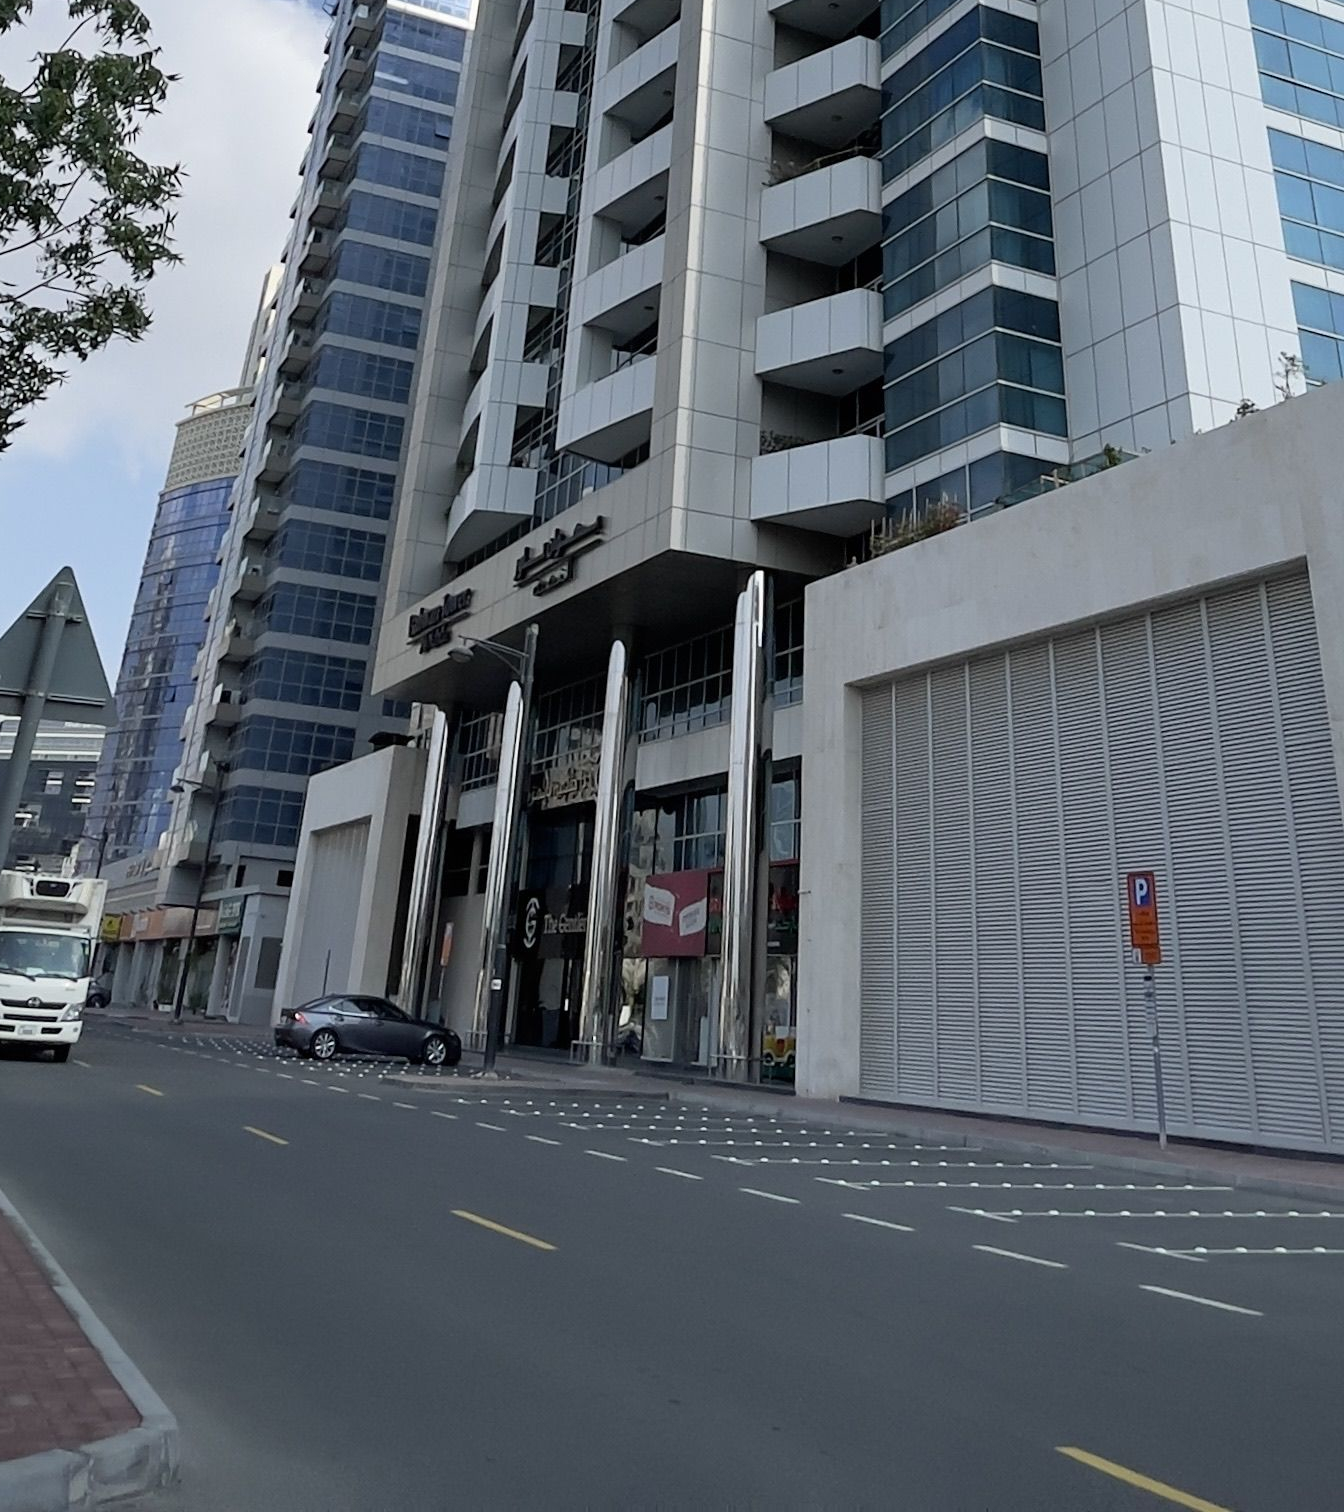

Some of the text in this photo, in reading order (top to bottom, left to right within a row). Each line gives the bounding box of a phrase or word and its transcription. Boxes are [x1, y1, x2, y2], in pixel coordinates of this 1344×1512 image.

[1135, 878, 1148, 905] P
[544, 912, 587, 934] The Gentle
